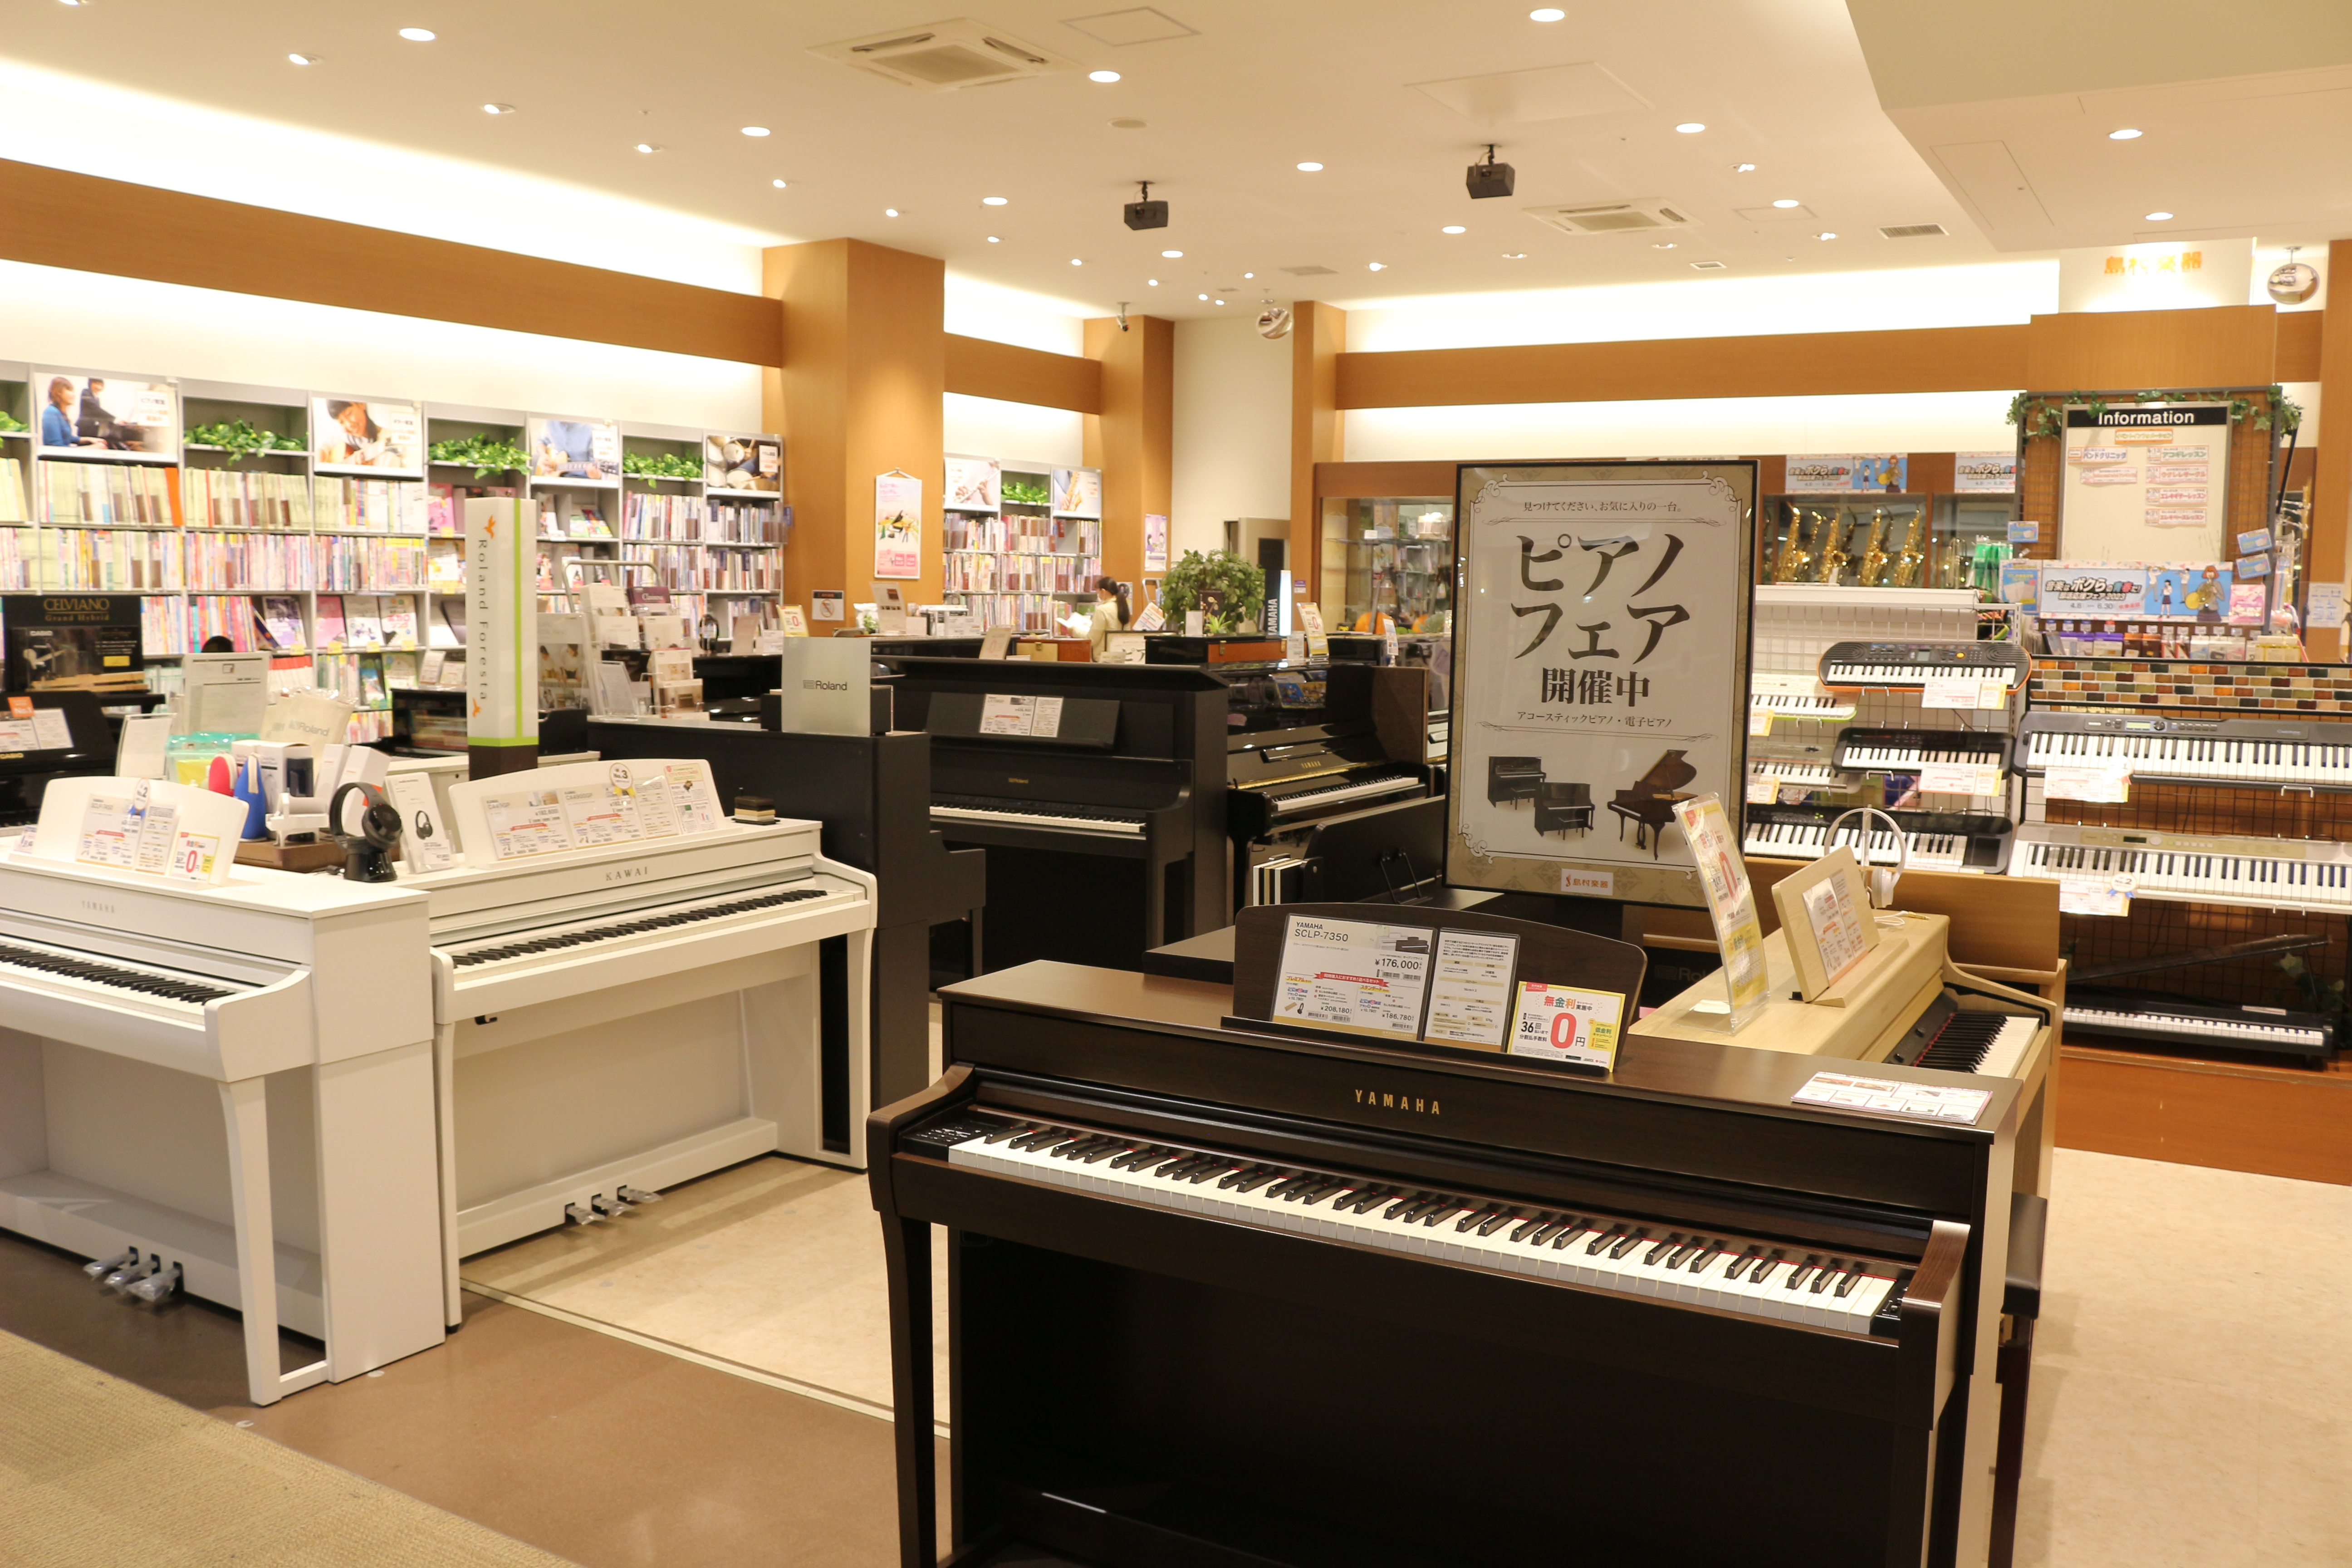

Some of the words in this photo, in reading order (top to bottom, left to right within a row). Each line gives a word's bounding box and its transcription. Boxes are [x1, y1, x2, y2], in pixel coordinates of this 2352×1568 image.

[2098, 411, 2194, 425] Information
[1523, 501, 1682, 513] 見つけてください、お気に入りの一台。
[1517, 534, 1684, 597] ピアノ
[478, 539, 489, 609] Roland
[44, 598, 110, 611] CELVIANO
[78, 614, 109, 622] Hybrid
[1511, 602, 1690, 665] フェア
[479, 621, 488, 700] Foresta
[815, 681, 847, 690] Roland
[1541, 667, 1650, 707] 開催中
[1517, 710, 1672, 727] アコースティックピアノ・電子ピアノ
[300, 722, 329, 736] Roland
[606, 867, 647, 881] KAWAI
[1573, 878, 1608, 888] 島村楽器
[82, 900, 115, 913] YAMAHA
[1294, 929, 1348, 941] SCLP-7350
[1375, 958, 1419, 970] ¥176,000
[1544, 995, 1576, 1009] 無金利
[1521, 1022, 1534, 1033] 36
[1550, 1013, 1577, 1049] 0
[1575, 1036, 1586, 1047] 円
[1355, 1089, 1440, 1115] YAMAHA
